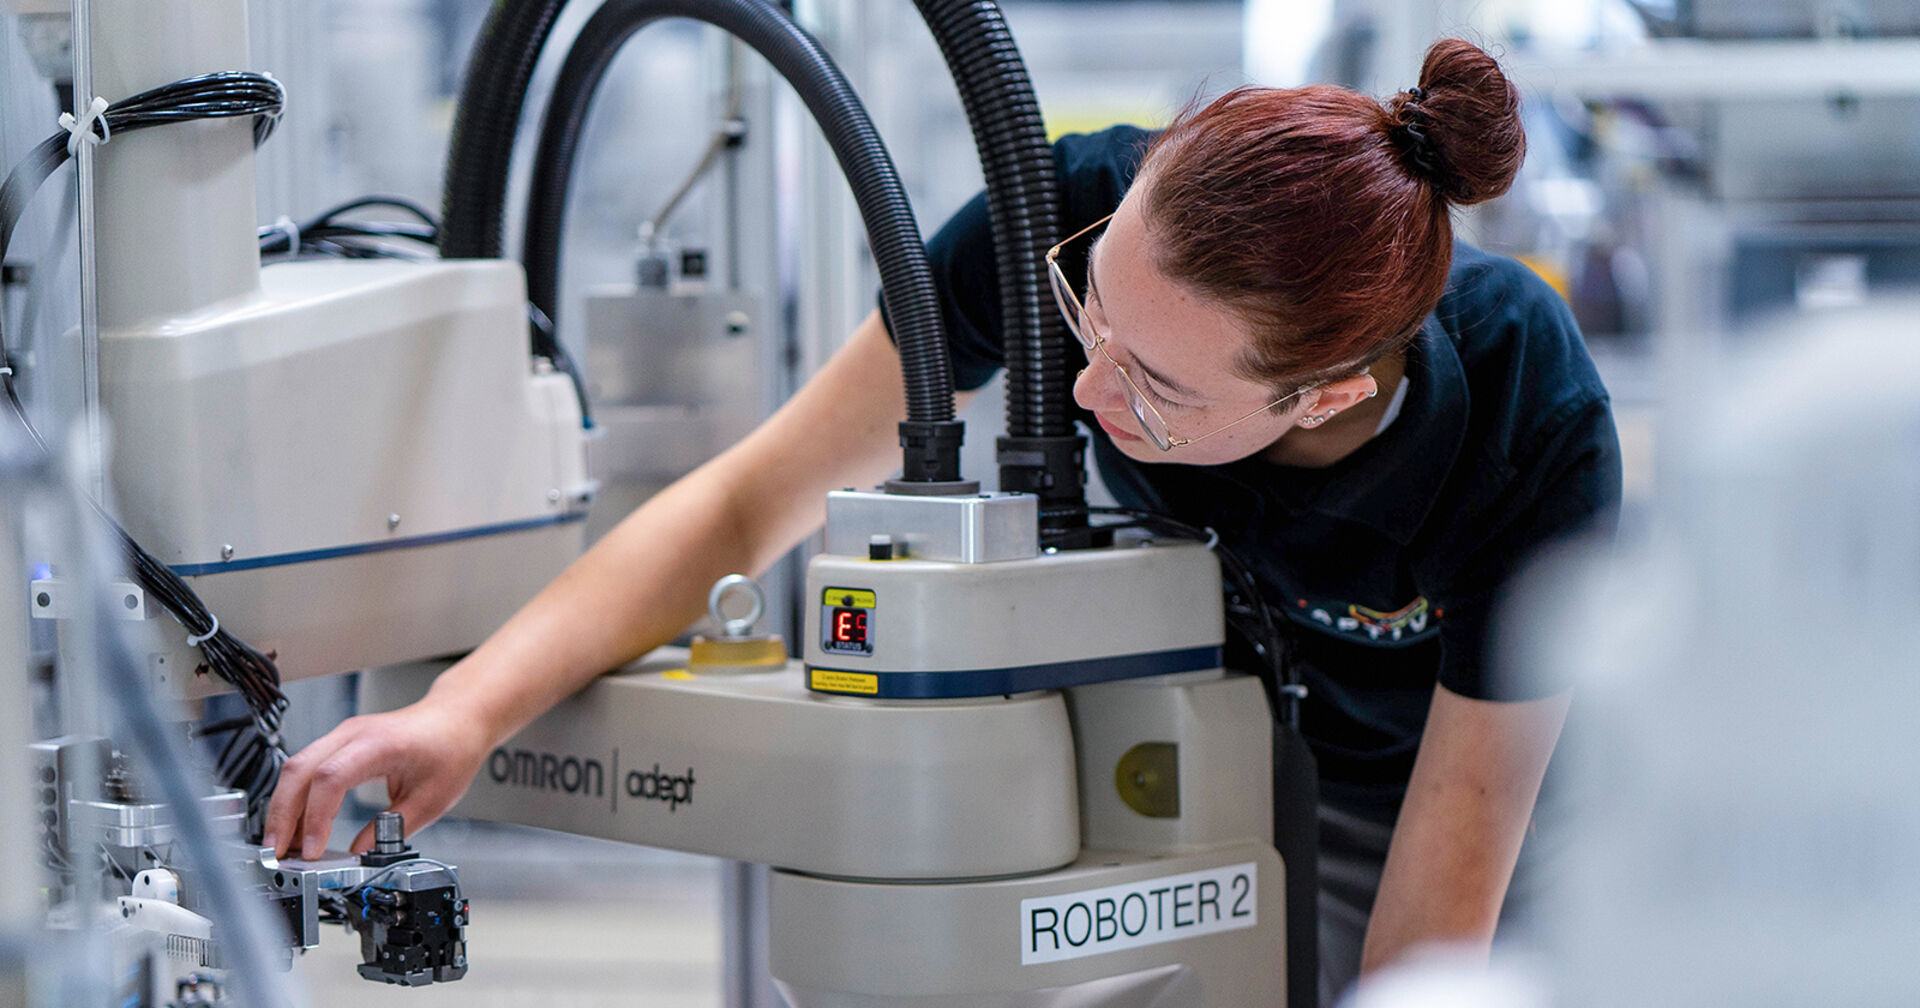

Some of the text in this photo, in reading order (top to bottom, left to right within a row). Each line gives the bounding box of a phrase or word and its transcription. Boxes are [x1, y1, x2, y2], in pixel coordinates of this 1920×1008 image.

[489, 747, 695, 812] OMRON adept
[1031, 873, 1251, 952] ROBOTER 2
